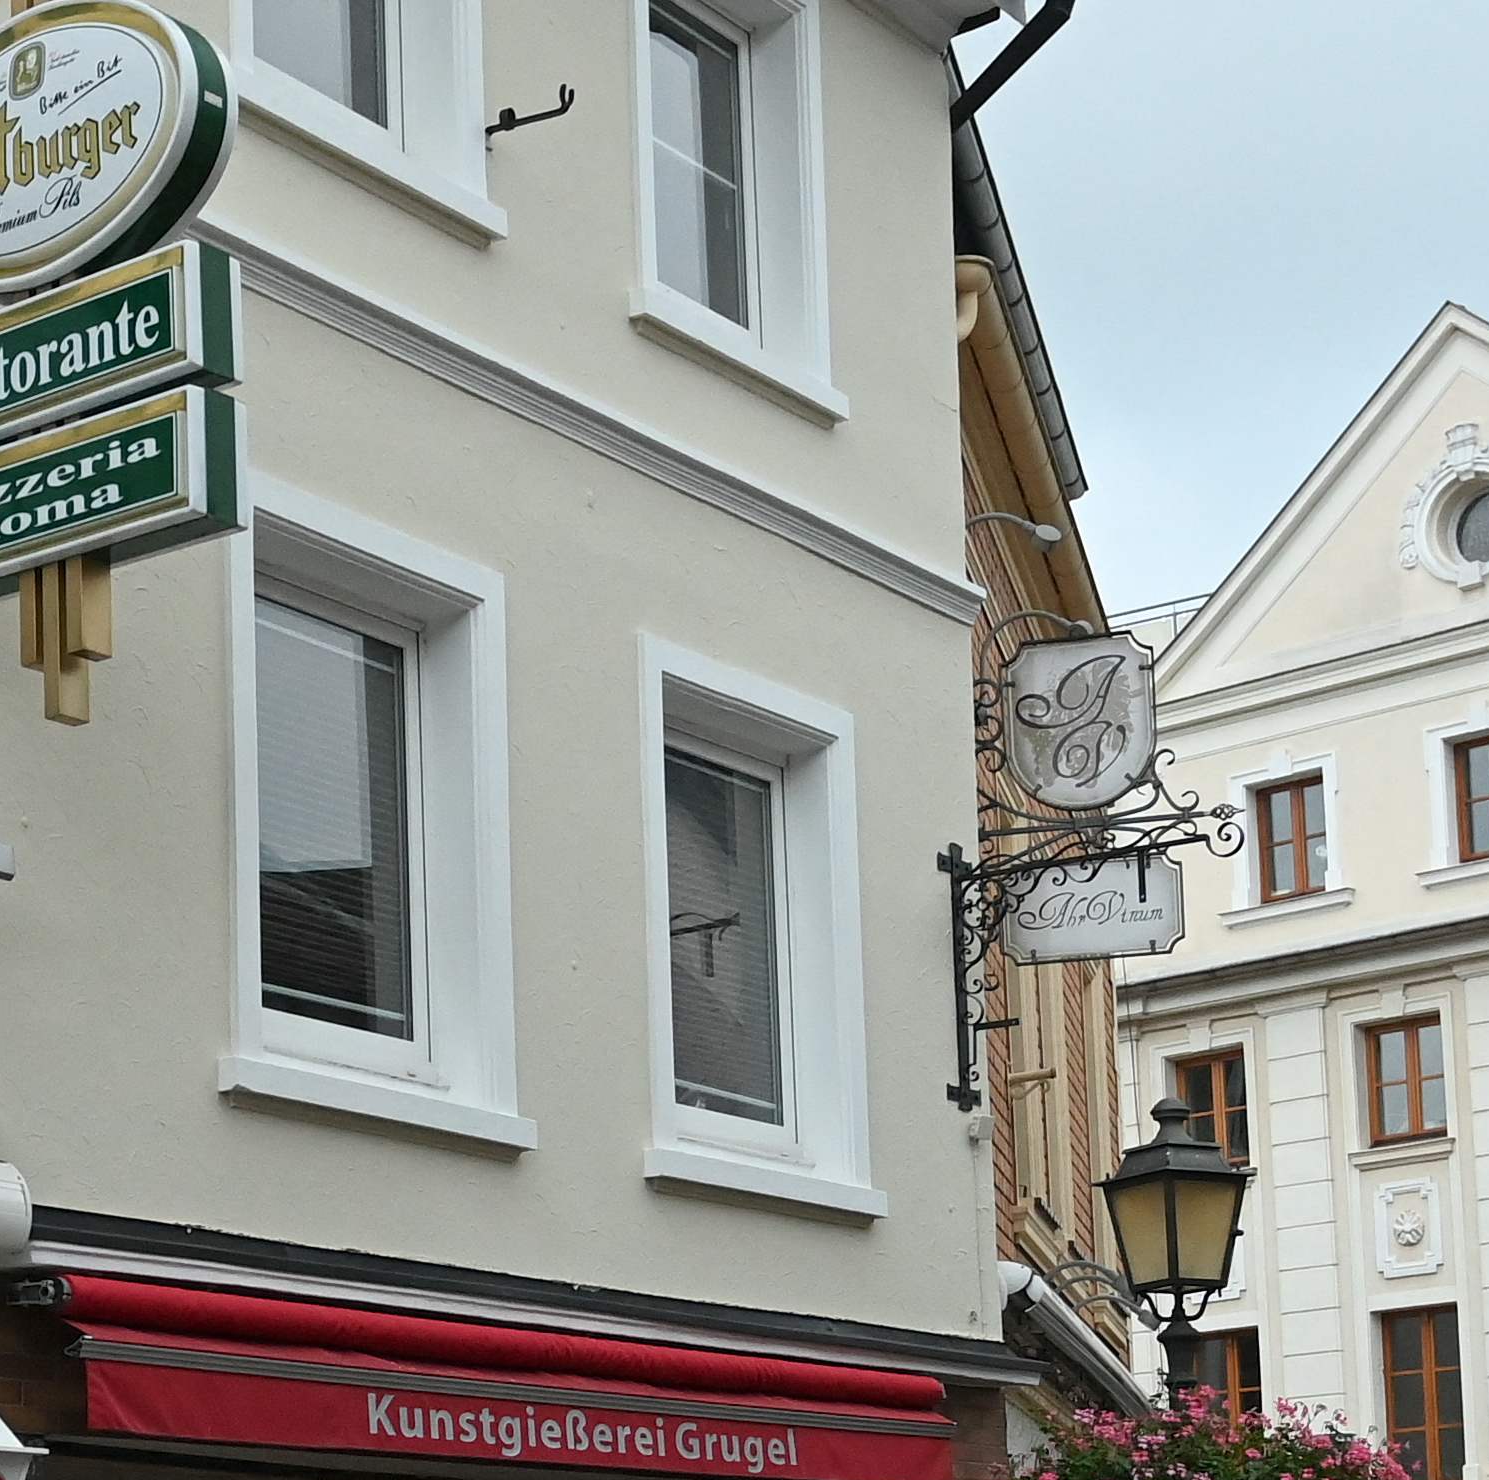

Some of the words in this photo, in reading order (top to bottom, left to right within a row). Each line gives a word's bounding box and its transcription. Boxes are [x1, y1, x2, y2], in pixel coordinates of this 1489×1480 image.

[40, 88, 69, 115] Bitte
[74, 79, 93, 95] ein
[97, 55, 122, 79] Bit
[39, 175, 82, 219] Pils
[366, 1391, 668, 1458] Kunstgießerei
[675, 1421, 799, 1475] Grugel
